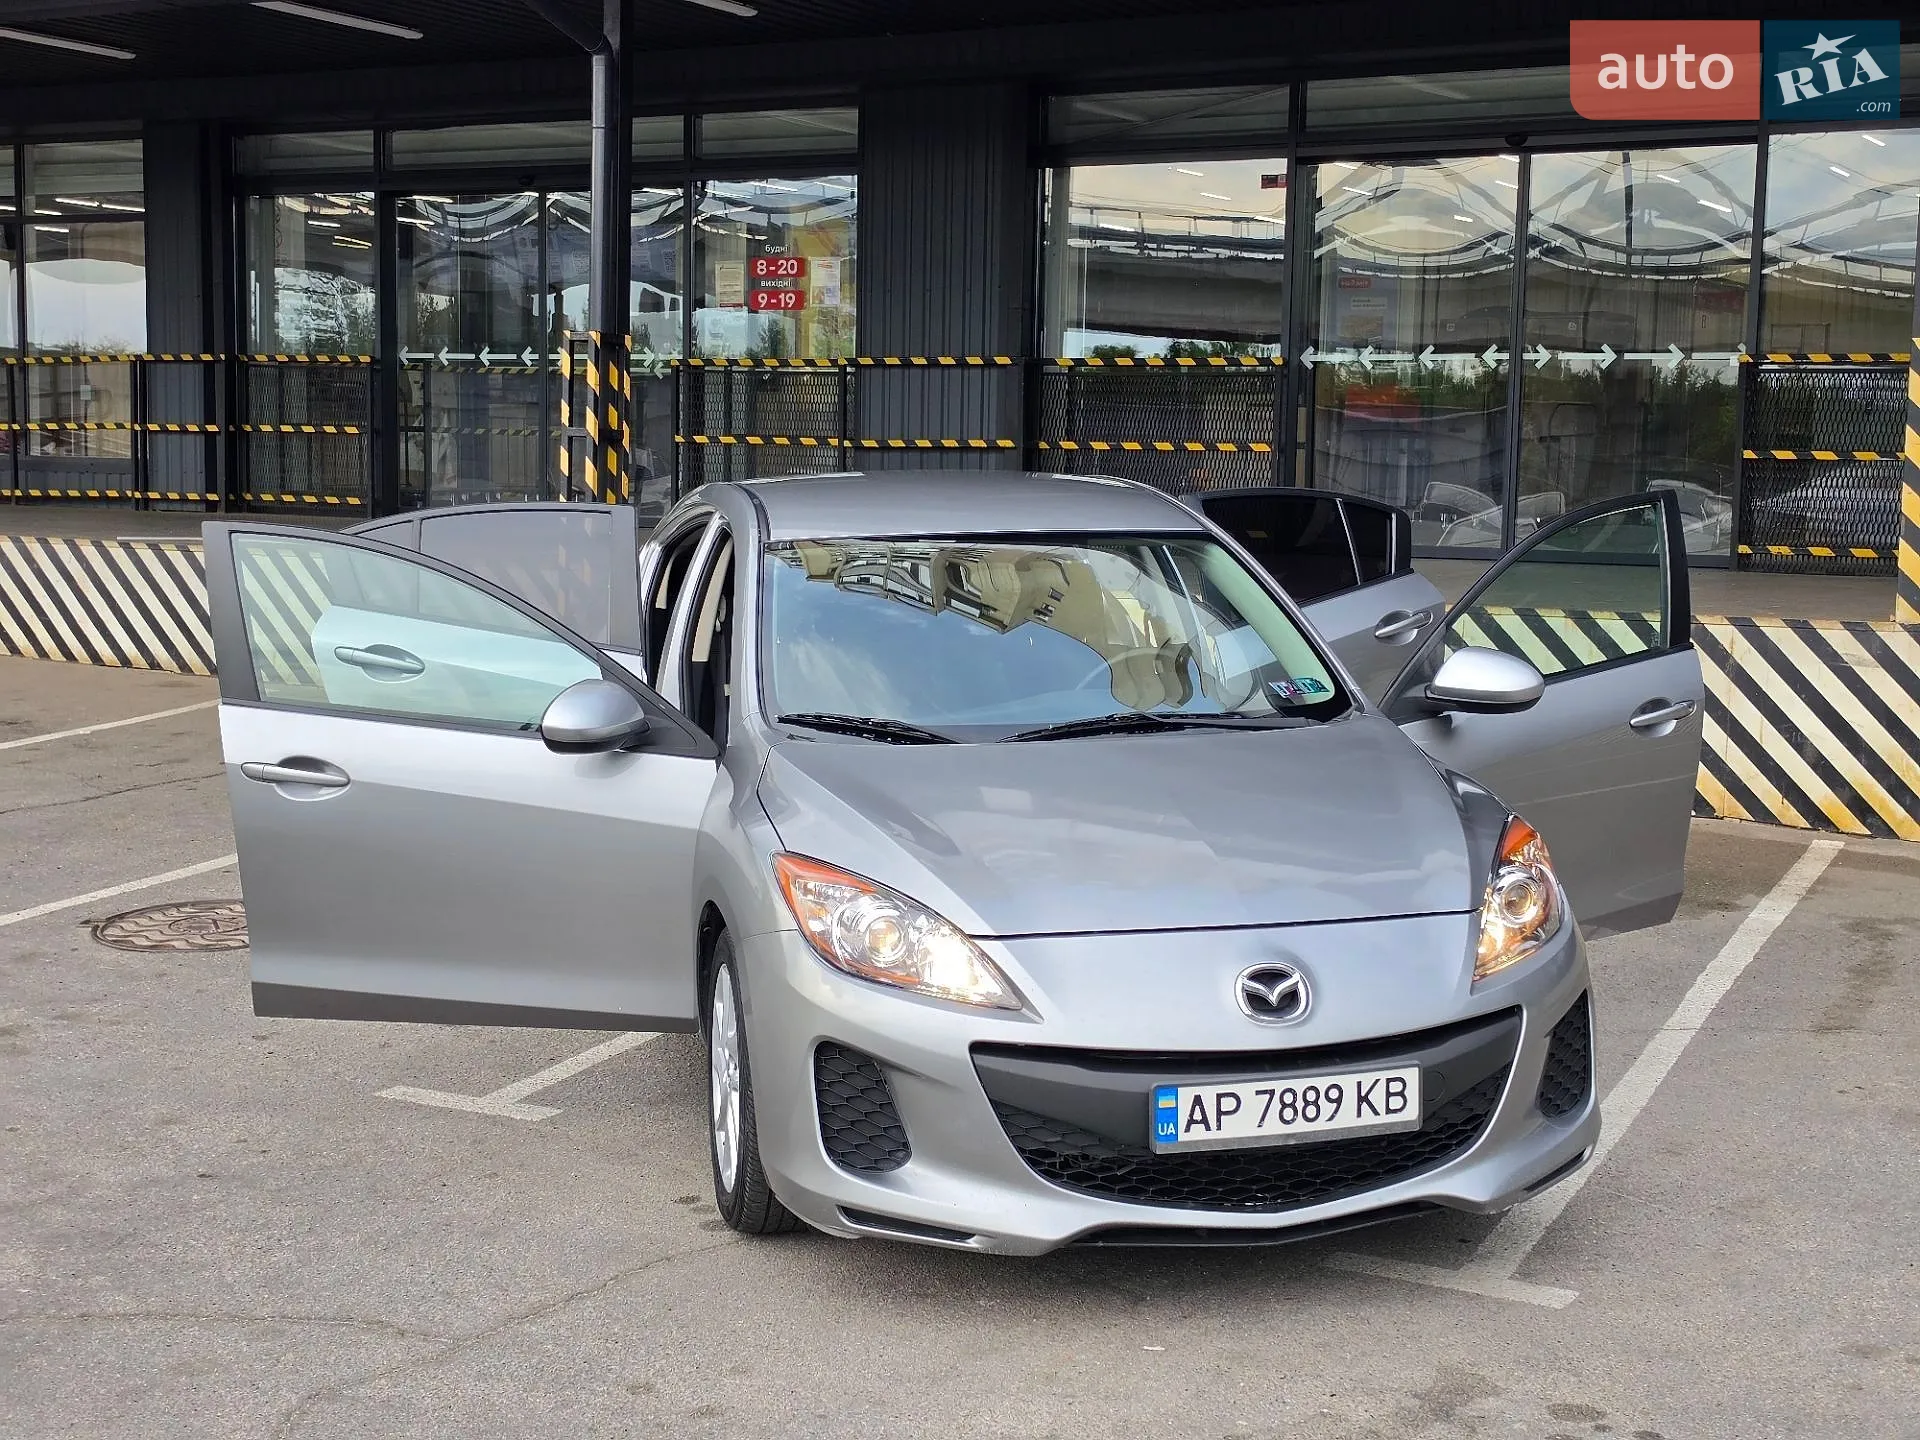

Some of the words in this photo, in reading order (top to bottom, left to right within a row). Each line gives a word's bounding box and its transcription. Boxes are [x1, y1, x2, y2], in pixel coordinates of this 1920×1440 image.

[765, 244, 788, 254] будні
[760, 278, 791, 288] вихідні
[1183, 1092, 1242, 1133] AP
[1255, 1083, 1344, 1128] 7889
[1356, 1076, 1408, 1119] KB
[1158, 1122, 1176, 1136] UA
